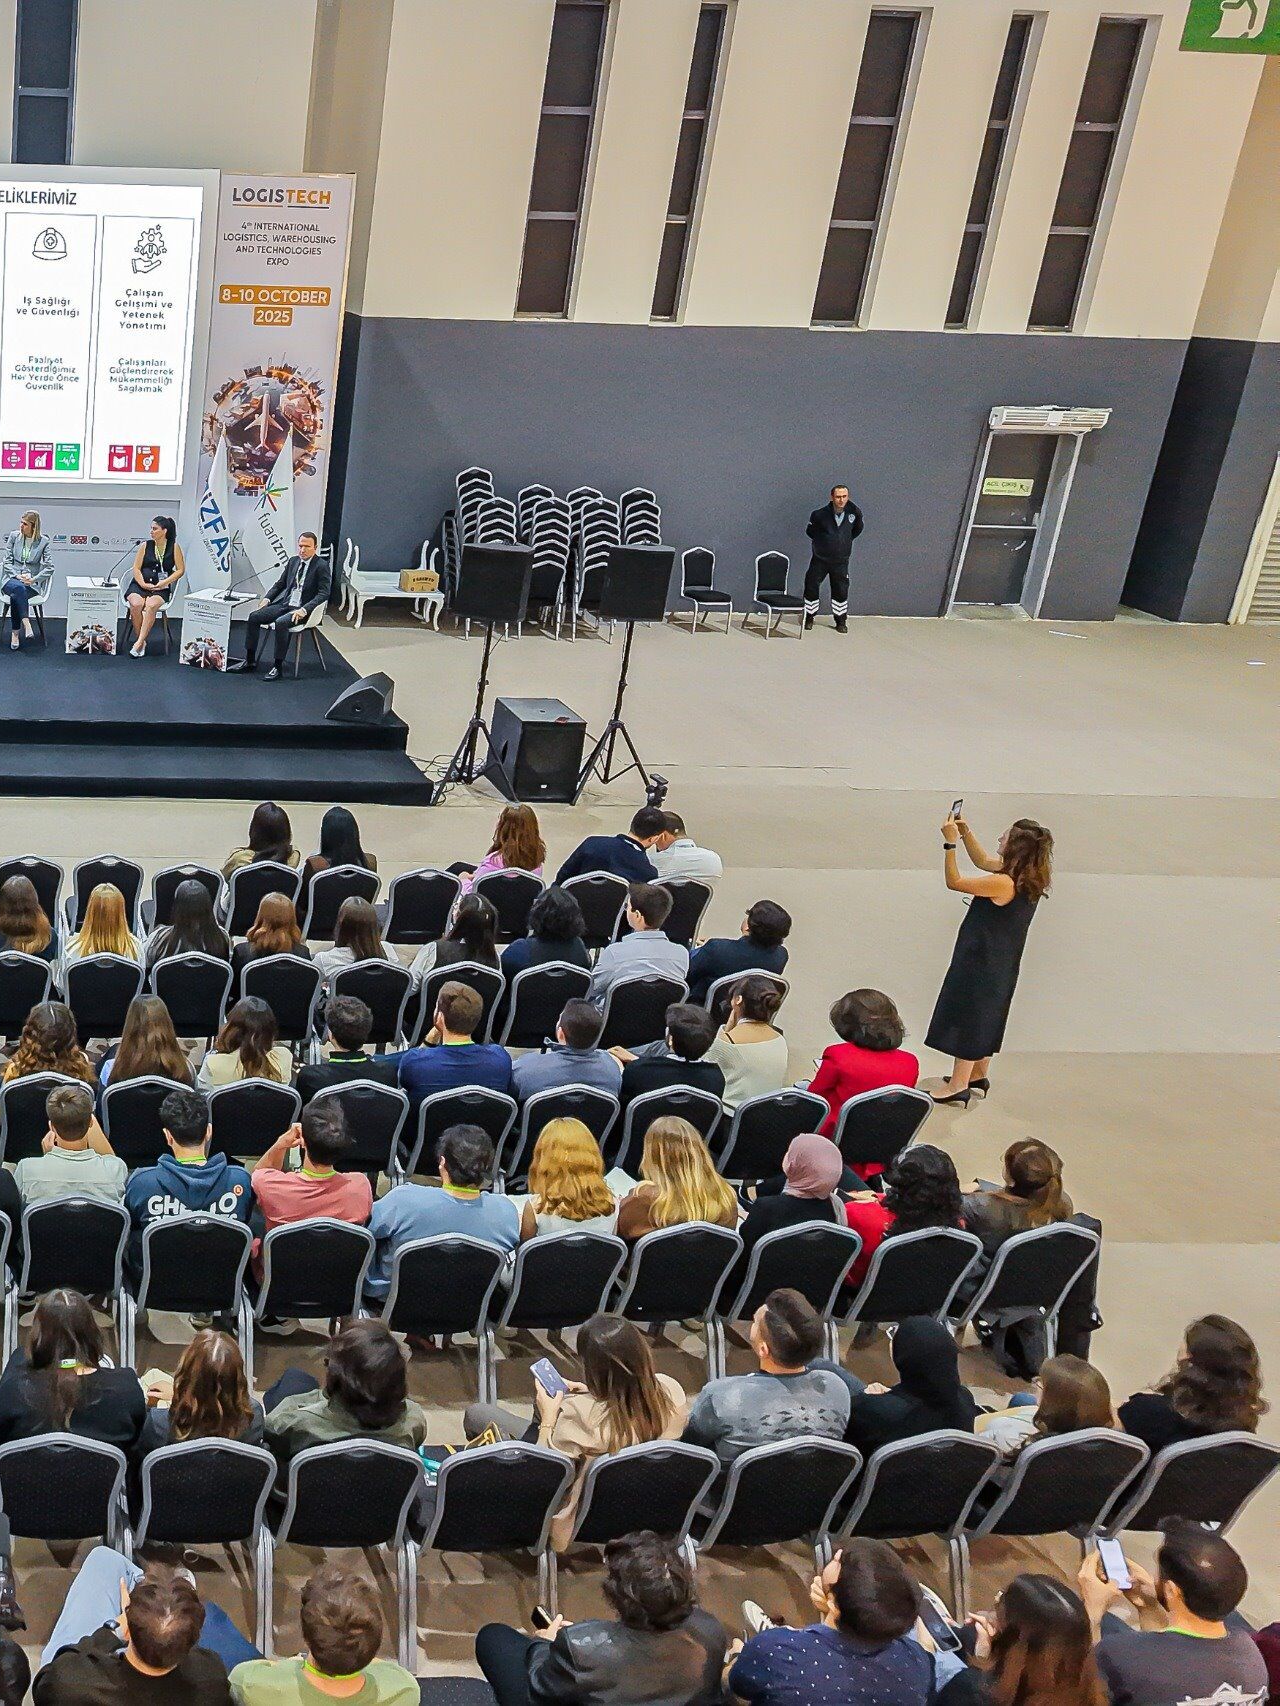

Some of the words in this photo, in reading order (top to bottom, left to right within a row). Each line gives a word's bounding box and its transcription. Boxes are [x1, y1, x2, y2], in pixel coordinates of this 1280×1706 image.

[232, 187, 332, 205] LOGISTECH
[253, 222, 320, 232] INTERNATIONAL
[223, 232, 270, 243] LOGISTICS,
[272, 234, 337, 245] WAREHOUSING
[235, 245, 255, 253] AND
[256, 246, 322, 255] TECHNOLOGIES
[266, 257, 290, 266] EXPO
[222, 288, 255, 302] 8-10
[258, 289, 328, 304] OCTOBER
[122, 310, 165, 319] Yetenek
[256, 309, 290, 323] 2025
[258, 512, 290, 565] fuarizm
